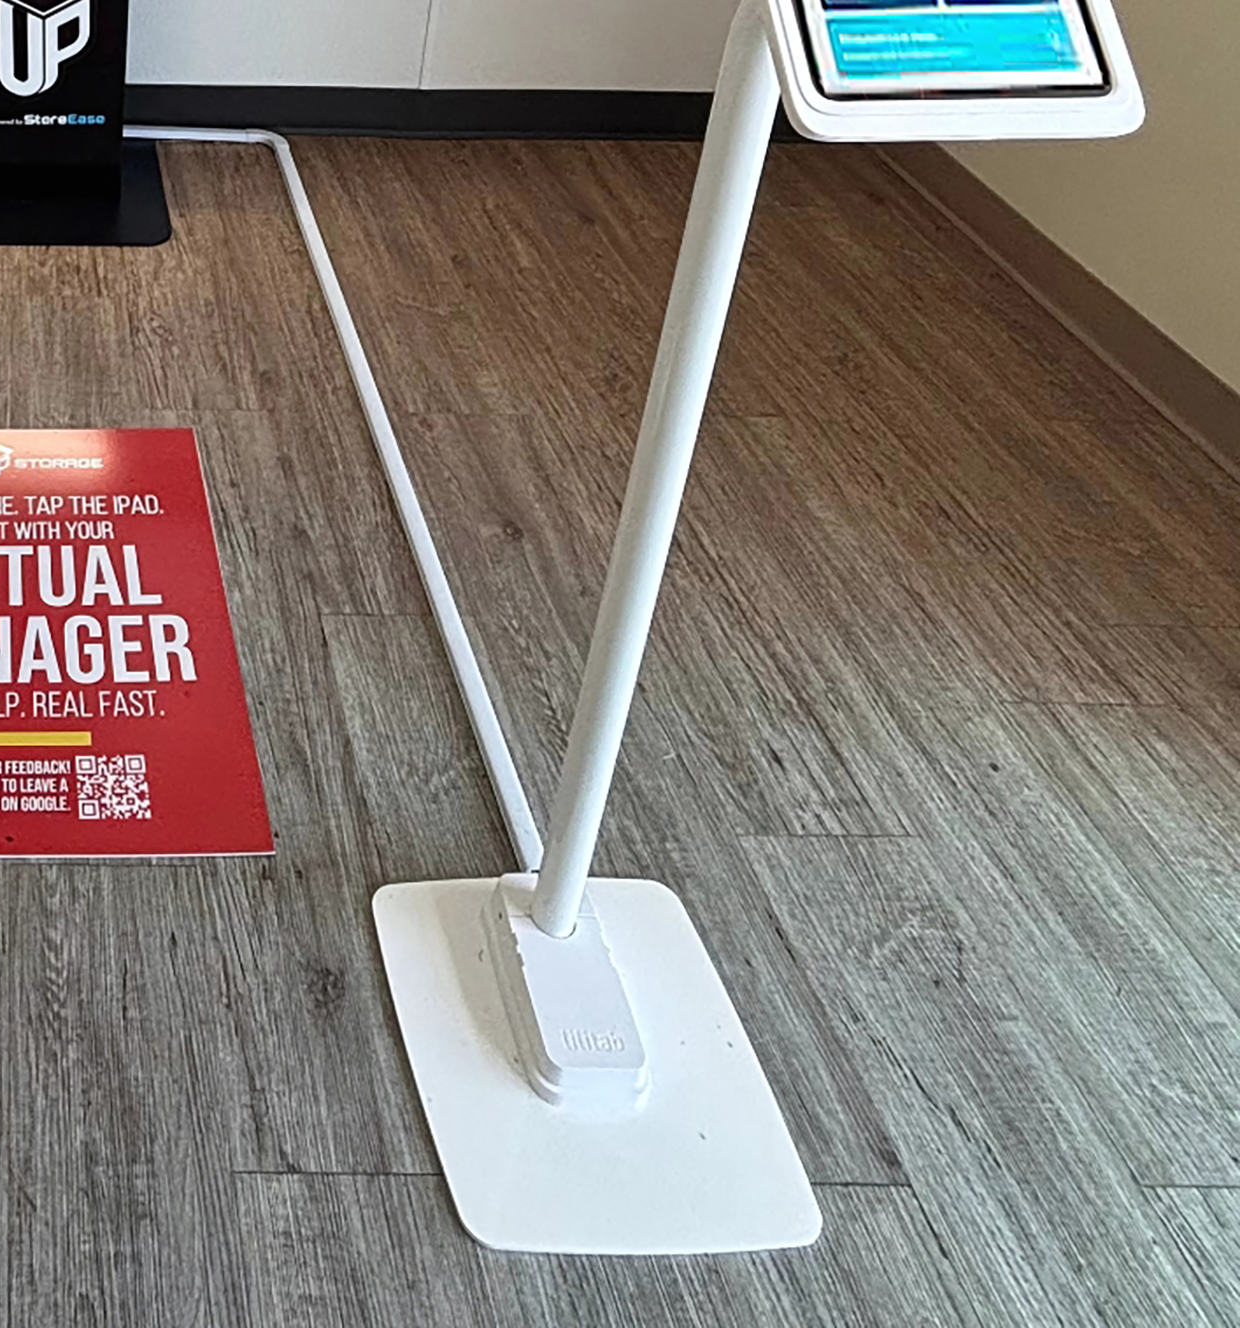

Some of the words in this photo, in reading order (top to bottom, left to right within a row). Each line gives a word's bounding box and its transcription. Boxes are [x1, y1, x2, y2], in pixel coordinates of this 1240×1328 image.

[13, 458, 104, 469] STORAGE
[23, 495, 64, 515] TAP
[68, 495, 110, 515] THE
[112, 495, 164, 515] IPAD.
[13, 521, 61, 540] WITH
[65, 521, 115, 540] YOUR
[32, 690, 93, 718] REAL
[99, 690, 166, 718] FAST.
[5, 760, 72, 775] FEEDBACK!
[1, 777, 18, 792] TO
[20, 777, 57, 792] LEAVE
[59, 777, 69, 792] A
[1, 796, 19, 811] ON
[21, 796, 72, 811] GOOGLE.
